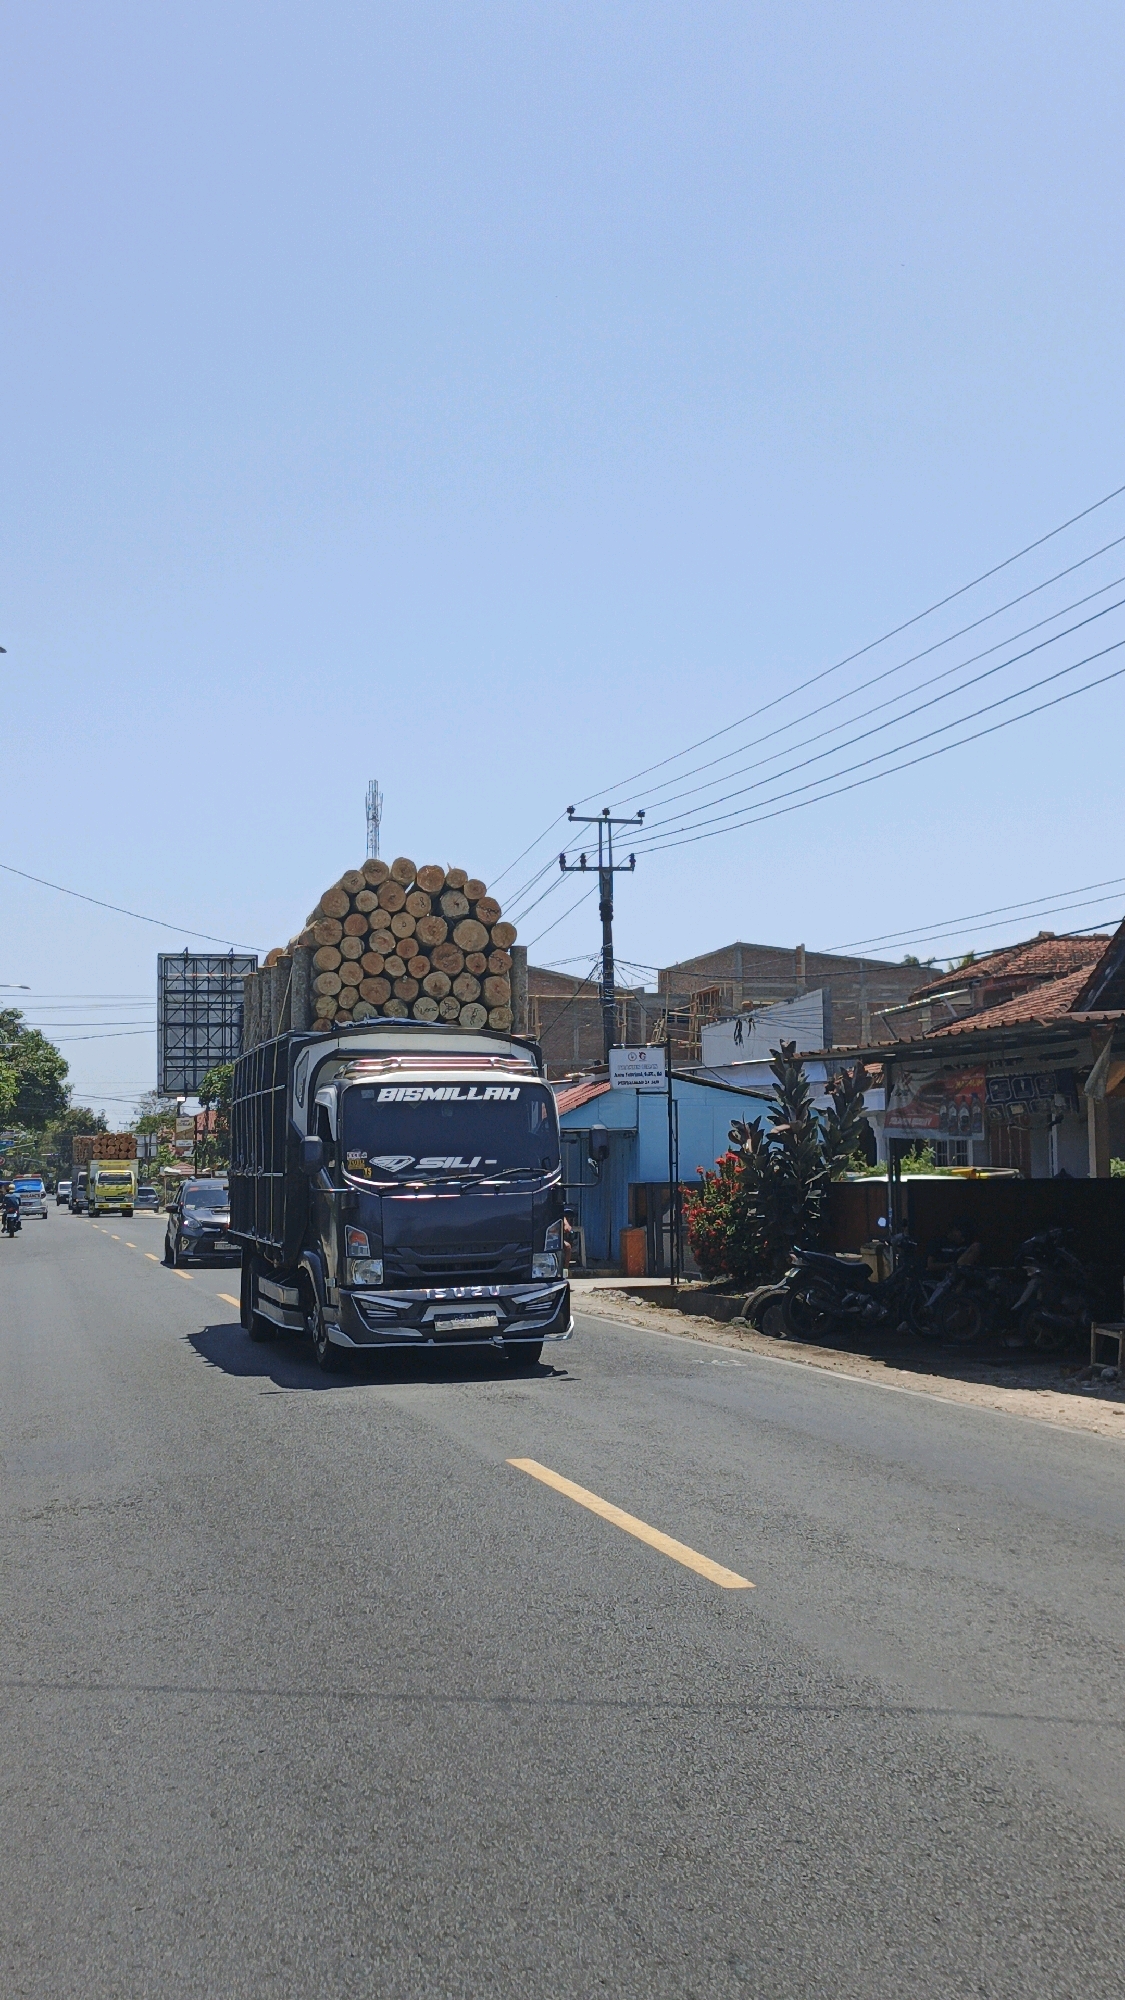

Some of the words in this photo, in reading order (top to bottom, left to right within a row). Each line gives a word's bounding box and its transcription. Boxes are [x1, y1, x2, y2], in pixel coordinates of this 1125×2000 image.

[377, 1087, 520, 1102] BISMILLAH
[414, 1156, 482, 1169] SILI
[425, 1285, 501, 1299] ISUZU
